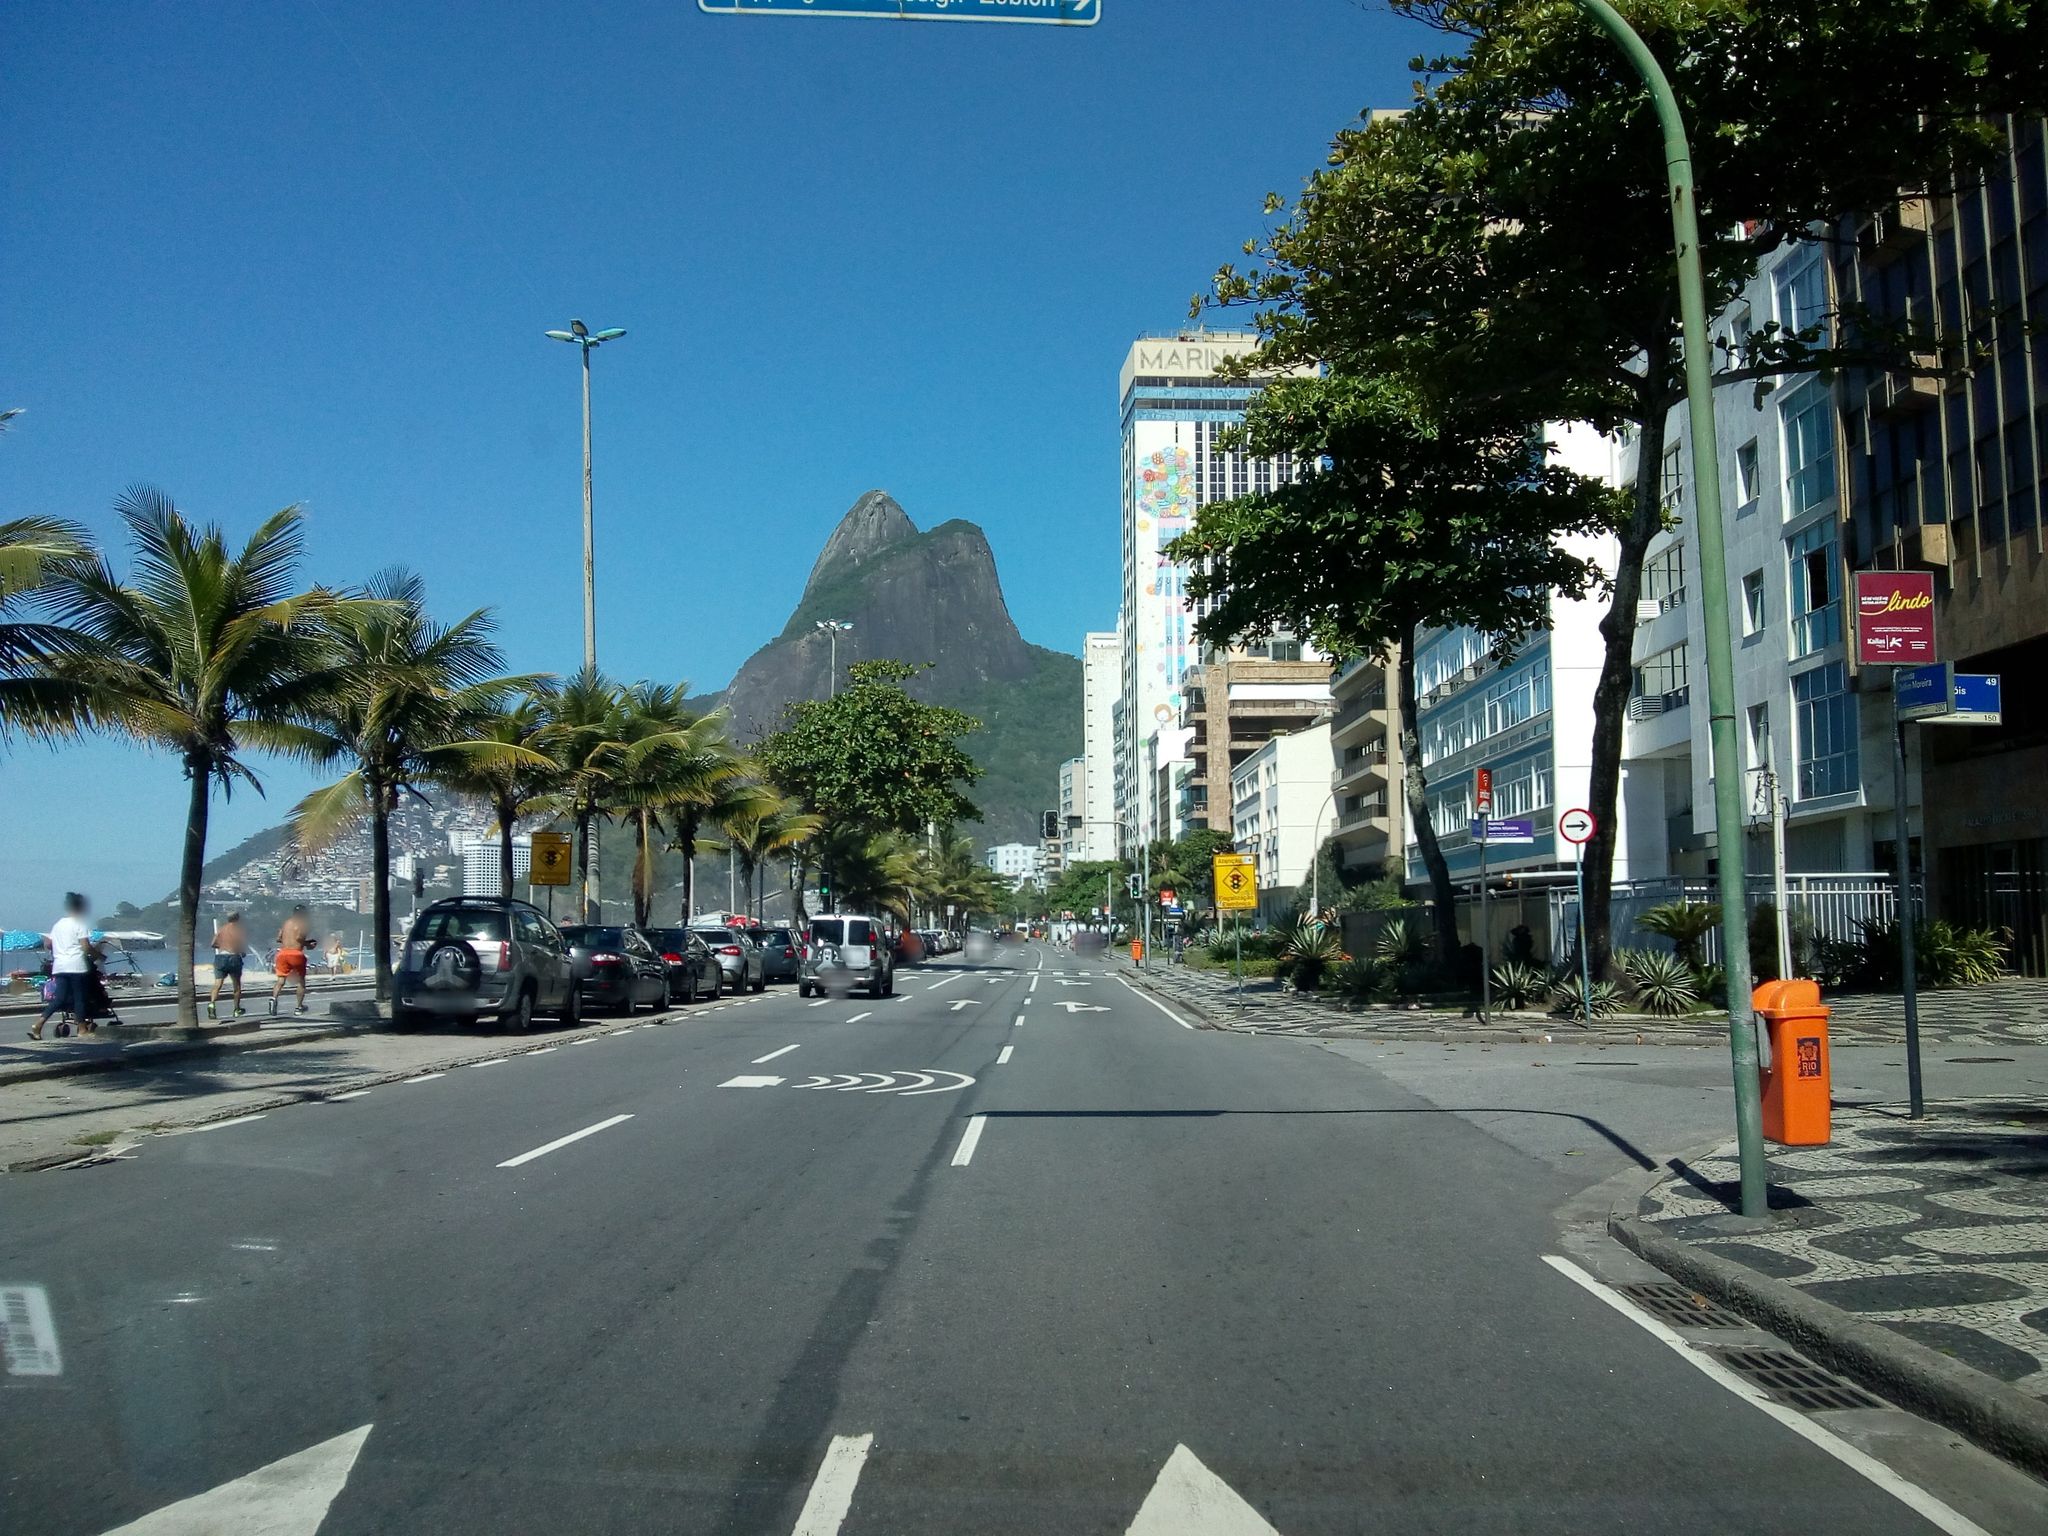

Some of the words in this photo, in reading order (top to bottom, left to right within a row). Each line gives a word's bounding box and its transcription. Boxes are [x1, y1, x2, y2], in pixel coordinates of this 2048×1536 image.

[1139, 347, 1241, 370] MARIN
[1888, 590, 1933, 611] lindo
[1912, 678, 1932, 689] Moreira
[1985, 678, 1997, 686] 49
[1954, 686, 1967, 695] óis
[1984, 714, 1997, 722] 150
[1802, 1061, 1817, 1070] RIO
